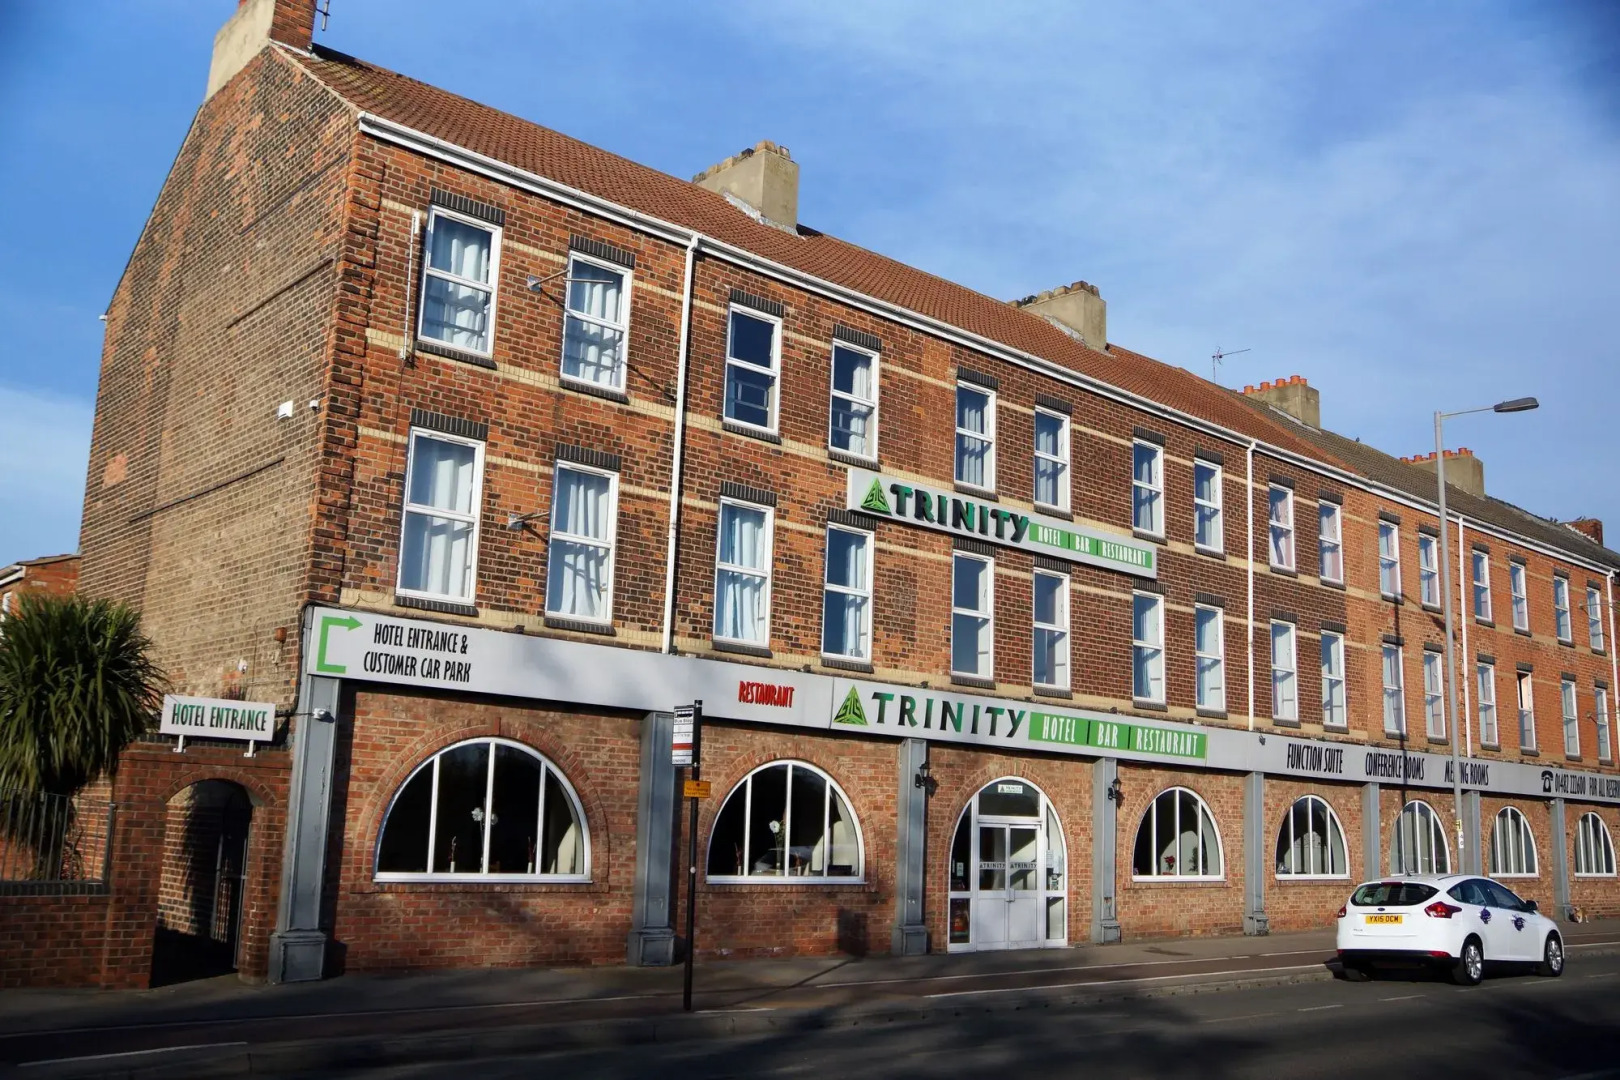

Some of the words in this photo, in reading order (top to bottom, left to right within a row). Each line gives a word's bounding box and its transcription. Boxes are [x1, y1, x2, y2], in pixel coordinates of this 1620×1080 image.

[890, 484, 1030, 543] TRINITY
[1038, 526, 1061, 546] HOTEL
[1075, 534, 1090, 554] BAR
[1102, 541, 1147, 566] RESTAURANT
[374, 623, 403, 646] HOTEL
[407, 627, 458, 653] ENTRANCE
[460, 634, 468, 654] &
[364, 651, 417, 677] CUSTOMER
[420, 657, 440, 679] CAR
[443, 660, 471, 683] PARK
[738, 681, 795, 708] RESTAURANT
[171, 703, 205, 727] HOTEL
[210, 706, 267, 731] ENTRANCE
[872, 691, 1026, 738] TRINITY
[1042, 716, 1076, 743] HOTEL
[1097, 723, 1118, 748] BAR
[1136, 728, 1198, 756] RESTAURANT
[1286, 743, 1322, 772] FUNCTION
[1323, 747, 1343, 774] SUITE
[1365, 752, 1402, 779] CONFERENCE
[1403, 756, 1425, 781] ROOMS
[1470, 763, 1489, 786] ROOMS
